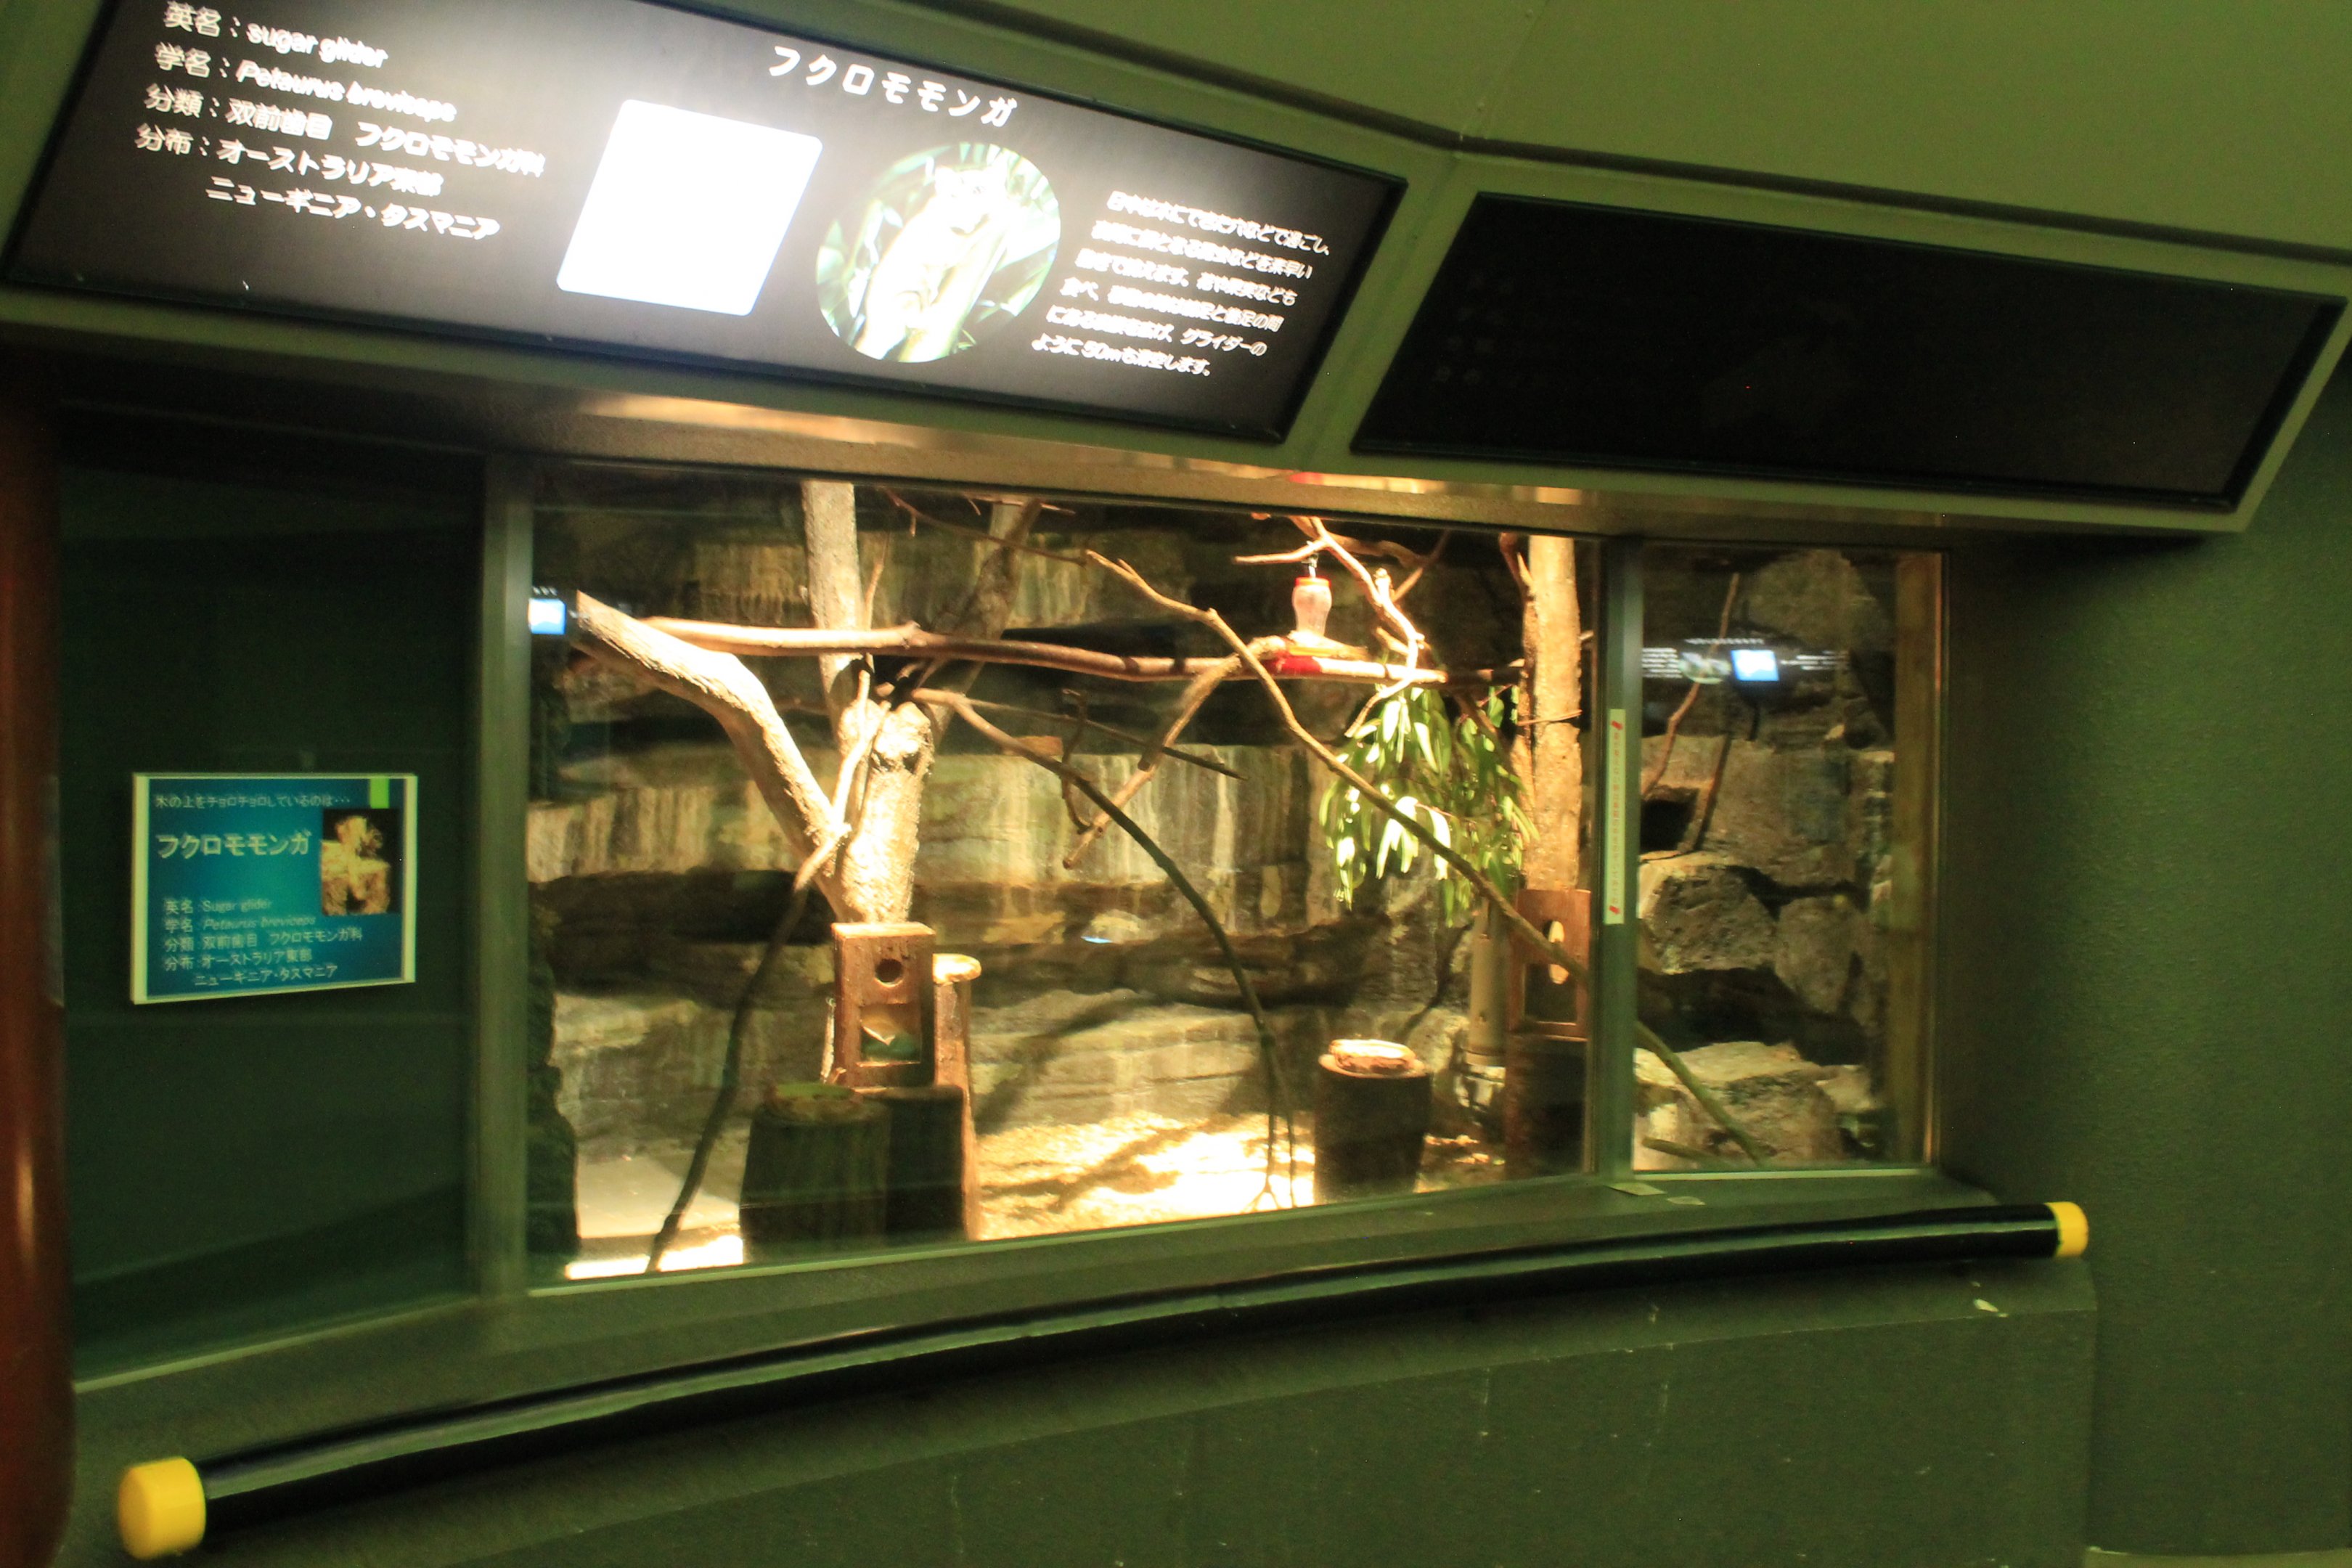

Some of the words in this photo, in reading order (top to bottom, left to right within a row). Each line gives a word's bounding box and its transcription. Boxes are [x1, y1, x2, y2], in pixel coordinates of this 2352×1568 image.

[246, 23, 318, 54] sugar
[235, 60, 346, 102] Petaurus
[767, 45, 1018, 128] フクロモモンガ
[157, 828, 313, 859] フクロモモンガ
